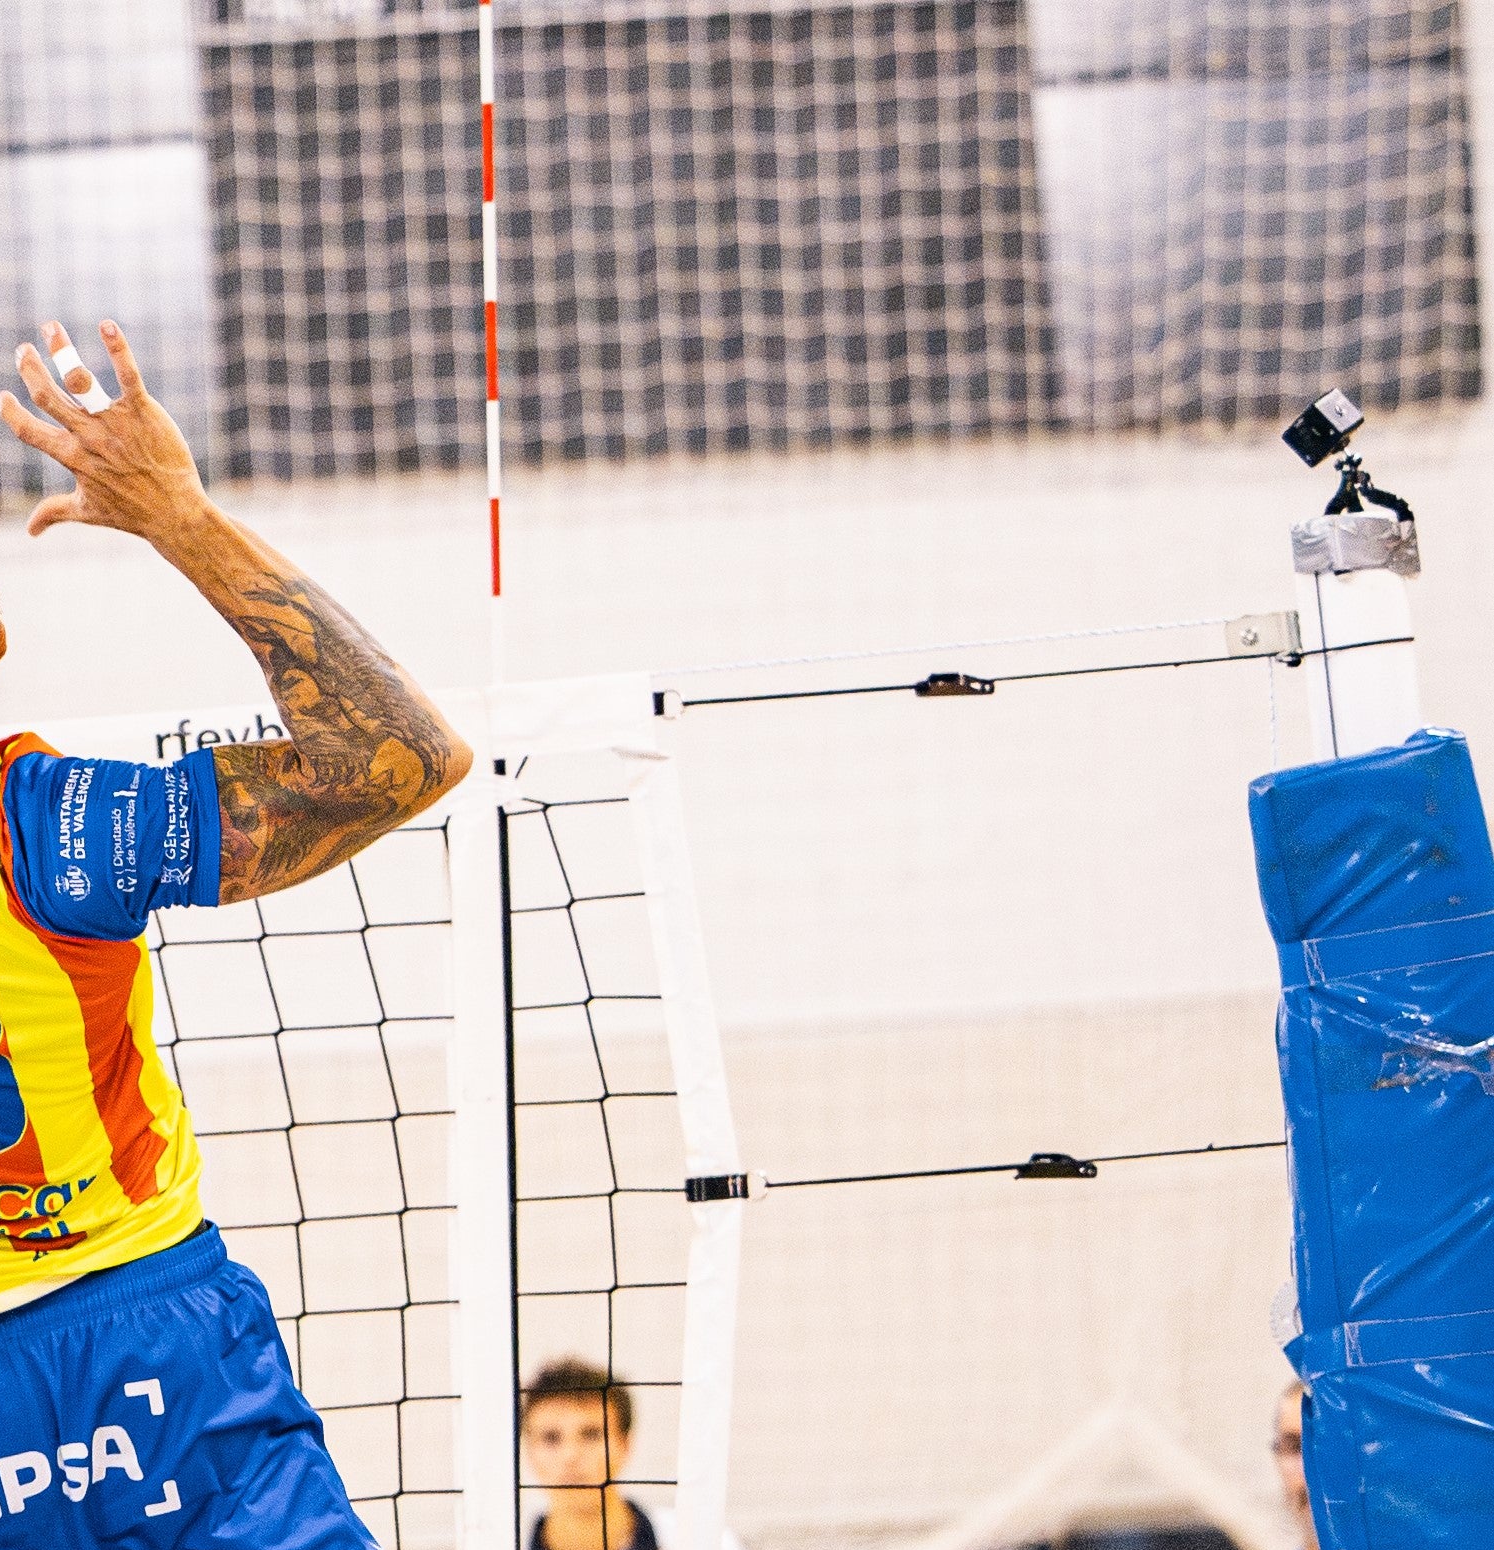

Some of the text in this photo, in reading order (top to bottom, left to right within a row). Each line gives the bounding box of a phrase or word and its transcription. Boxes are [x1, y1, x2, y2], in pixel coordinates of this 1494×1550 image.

[155, 714, 284, 759] rfevb
[59, 768, 82, 860] AJUNTAMENT
[74, 842, 87, 860] DE
[112, 808, 124, 867] Diputació
[126, 849, 136, 866] de
